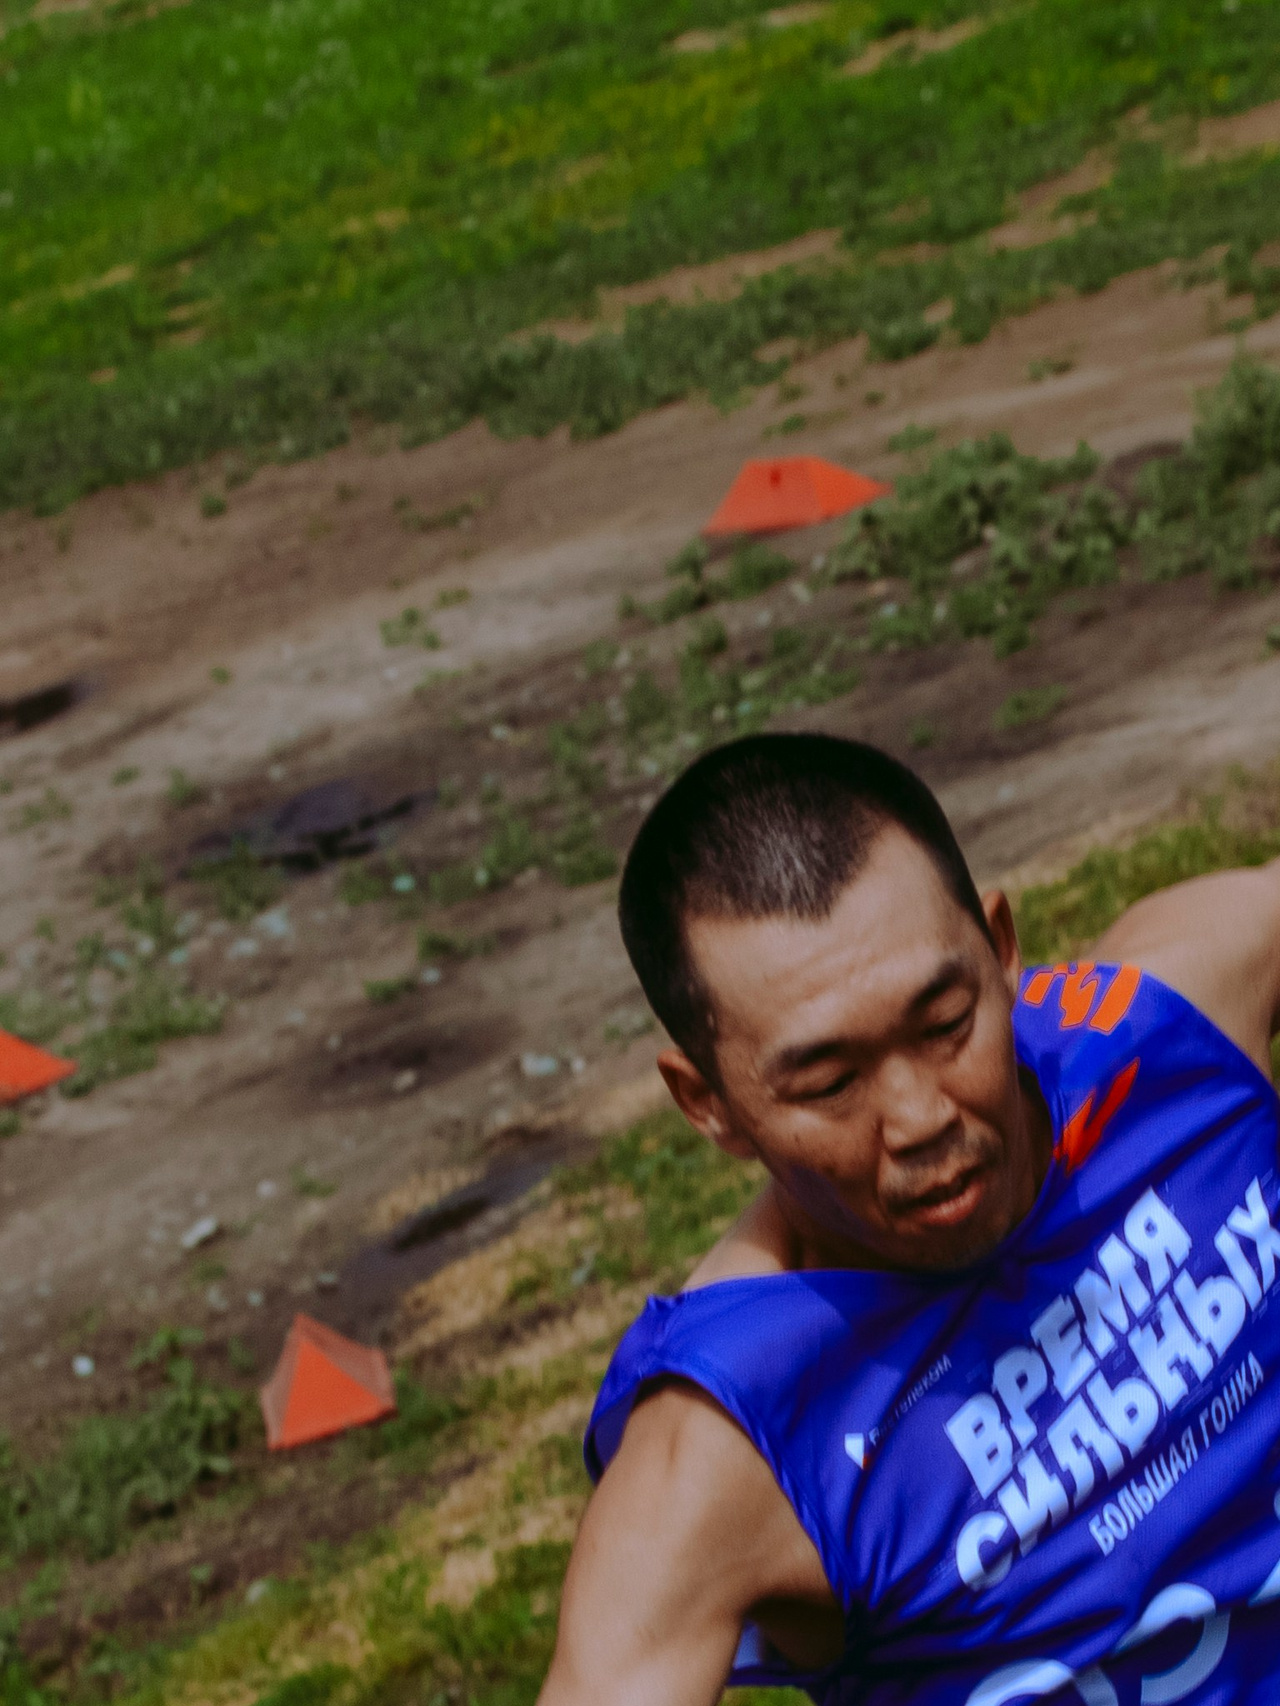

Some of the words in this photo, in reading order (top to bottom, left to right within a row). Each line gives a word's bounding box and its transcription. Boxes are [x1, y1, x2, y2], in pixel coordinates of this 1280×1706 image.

[943, 1185, 1192, 1500] ВРЕМЯ
[1088, 1425, 1199, 1557] БОЛЬШАЯ
[1199, 1351, 1264, 1450] ГОНКА
